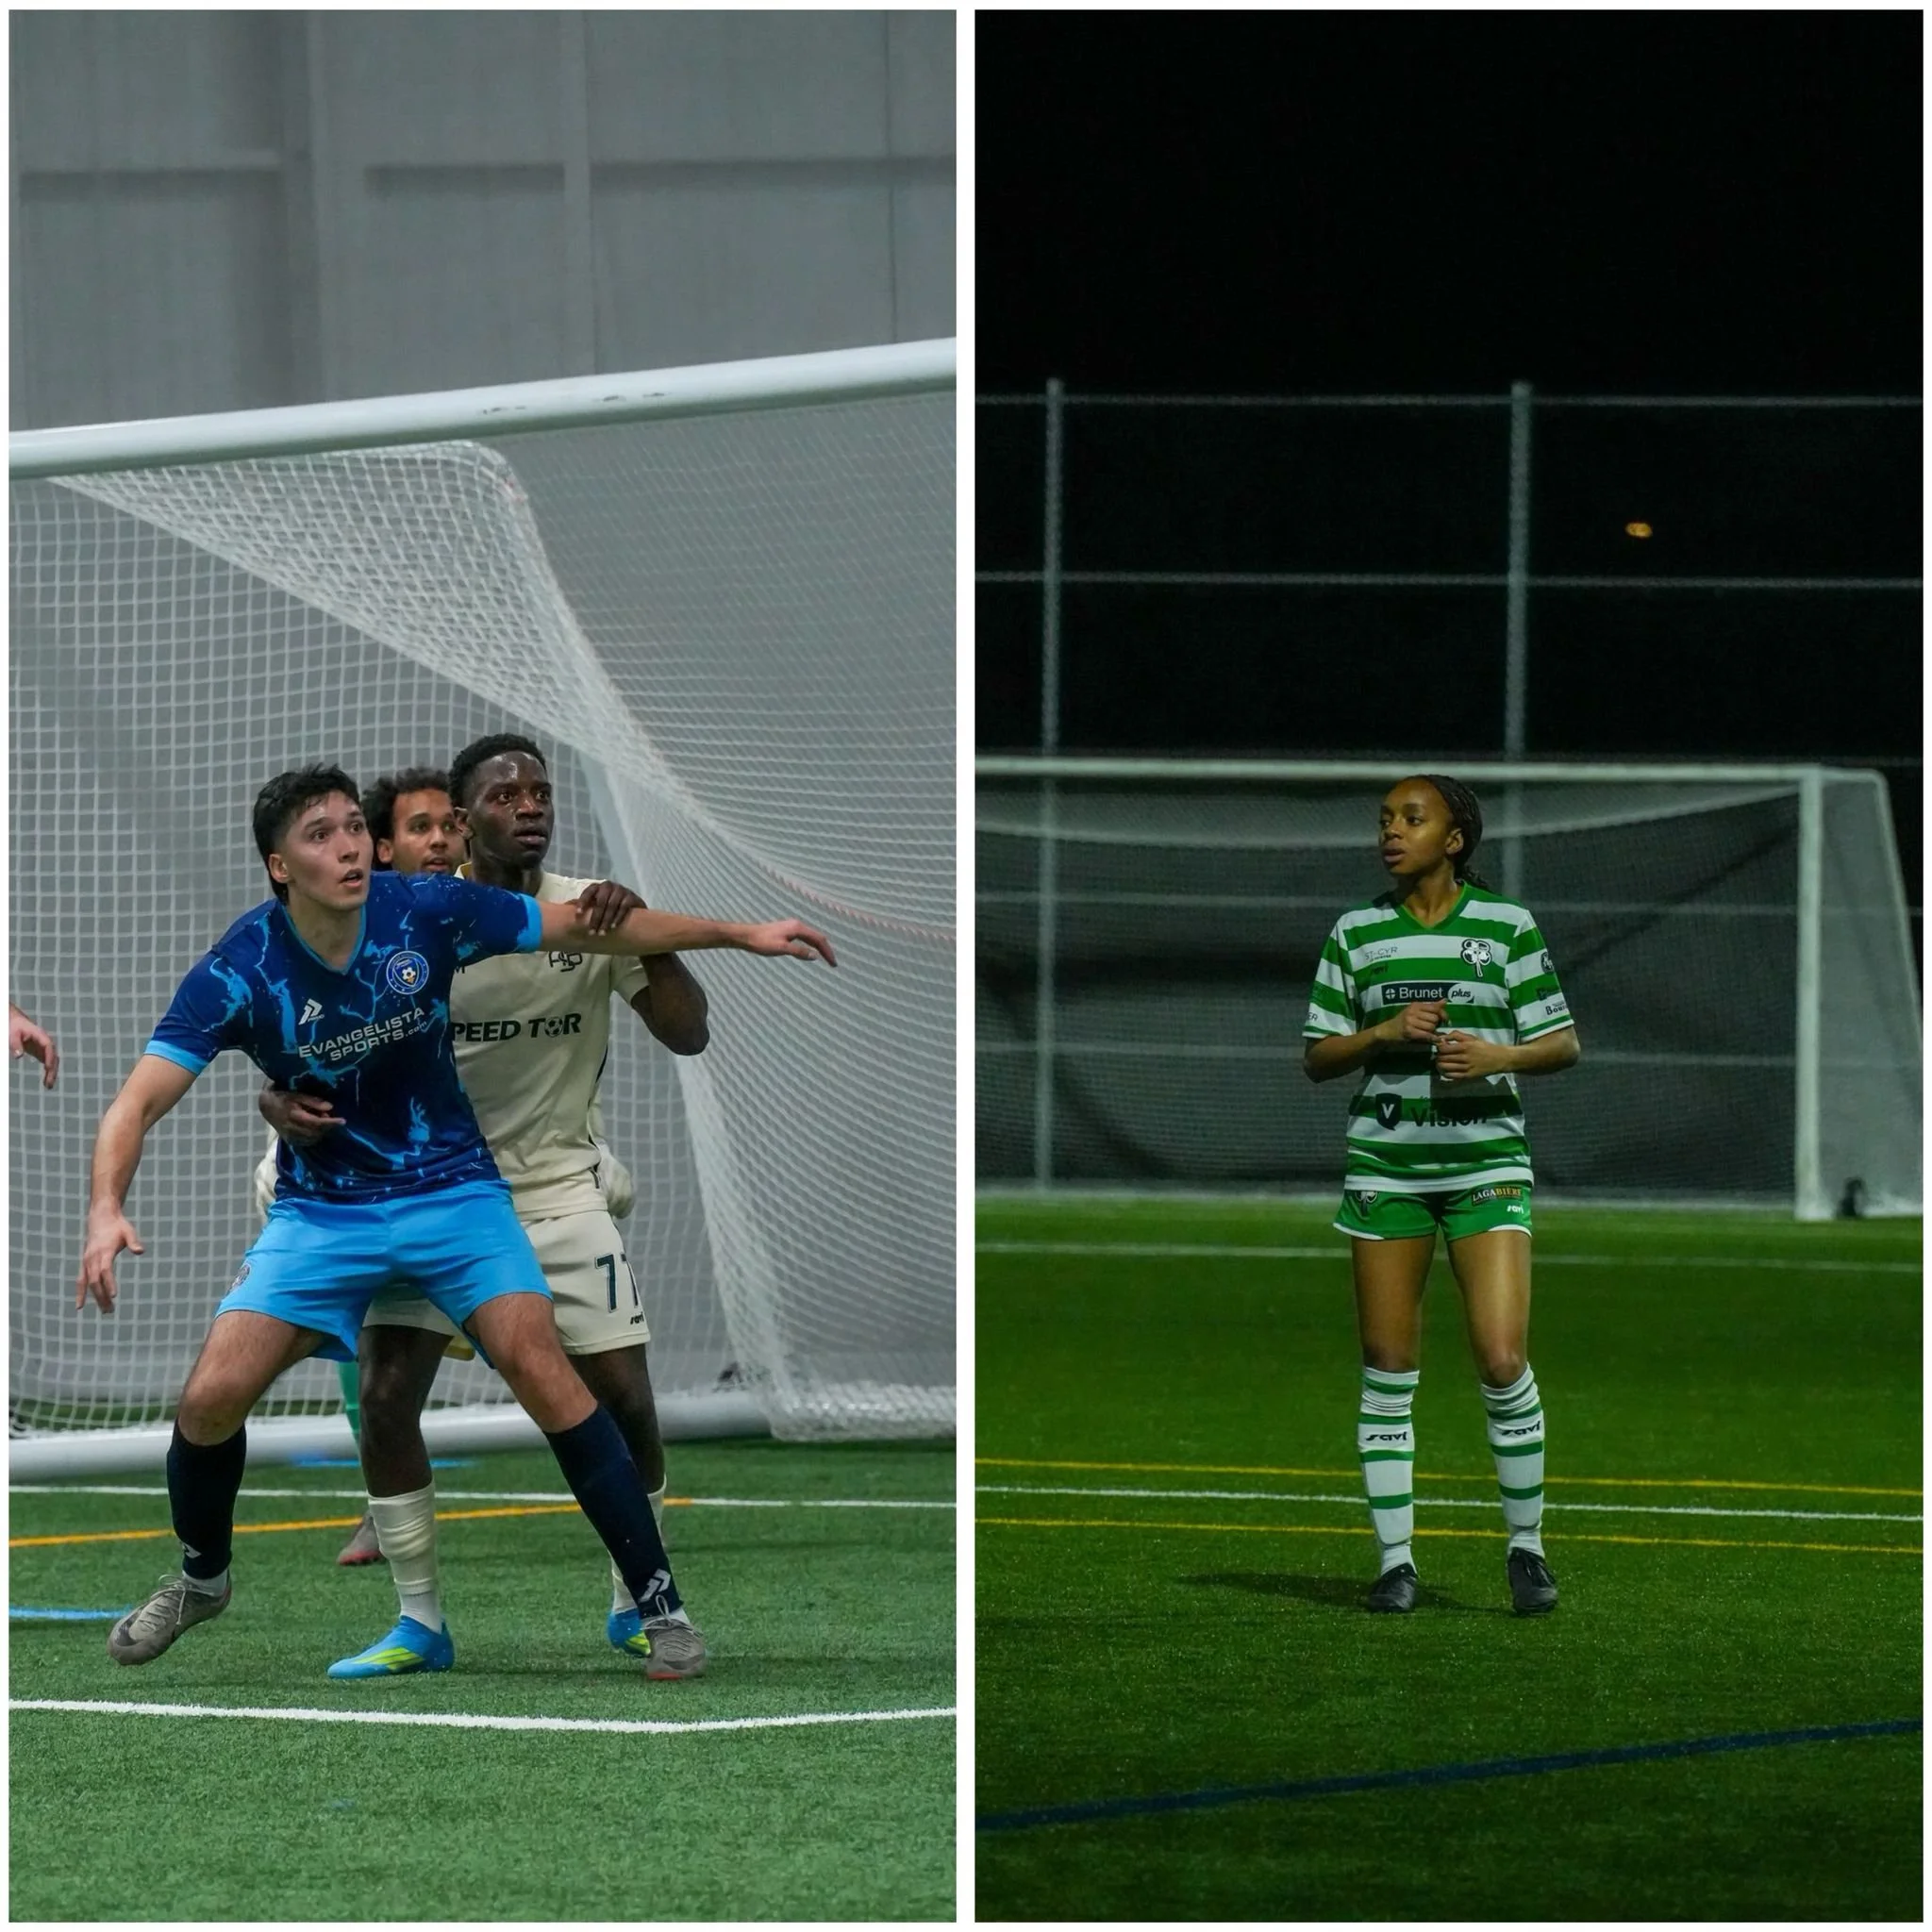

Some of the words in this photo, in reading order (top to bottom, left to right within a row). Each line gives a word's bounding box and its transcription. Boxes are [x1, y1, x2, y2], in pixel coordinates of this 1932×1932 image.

[1399, 987, 1443, 999] Brunet
[1450, 989, 1472, 999] plus
[298, 1007, 425, 1058] EVANGELISTA
[330, 1021, 427, 1061] SPORTS.com
[1366, 1431, 1407, 1441] savi
[1502, 1420, 1541, 1436] savi
